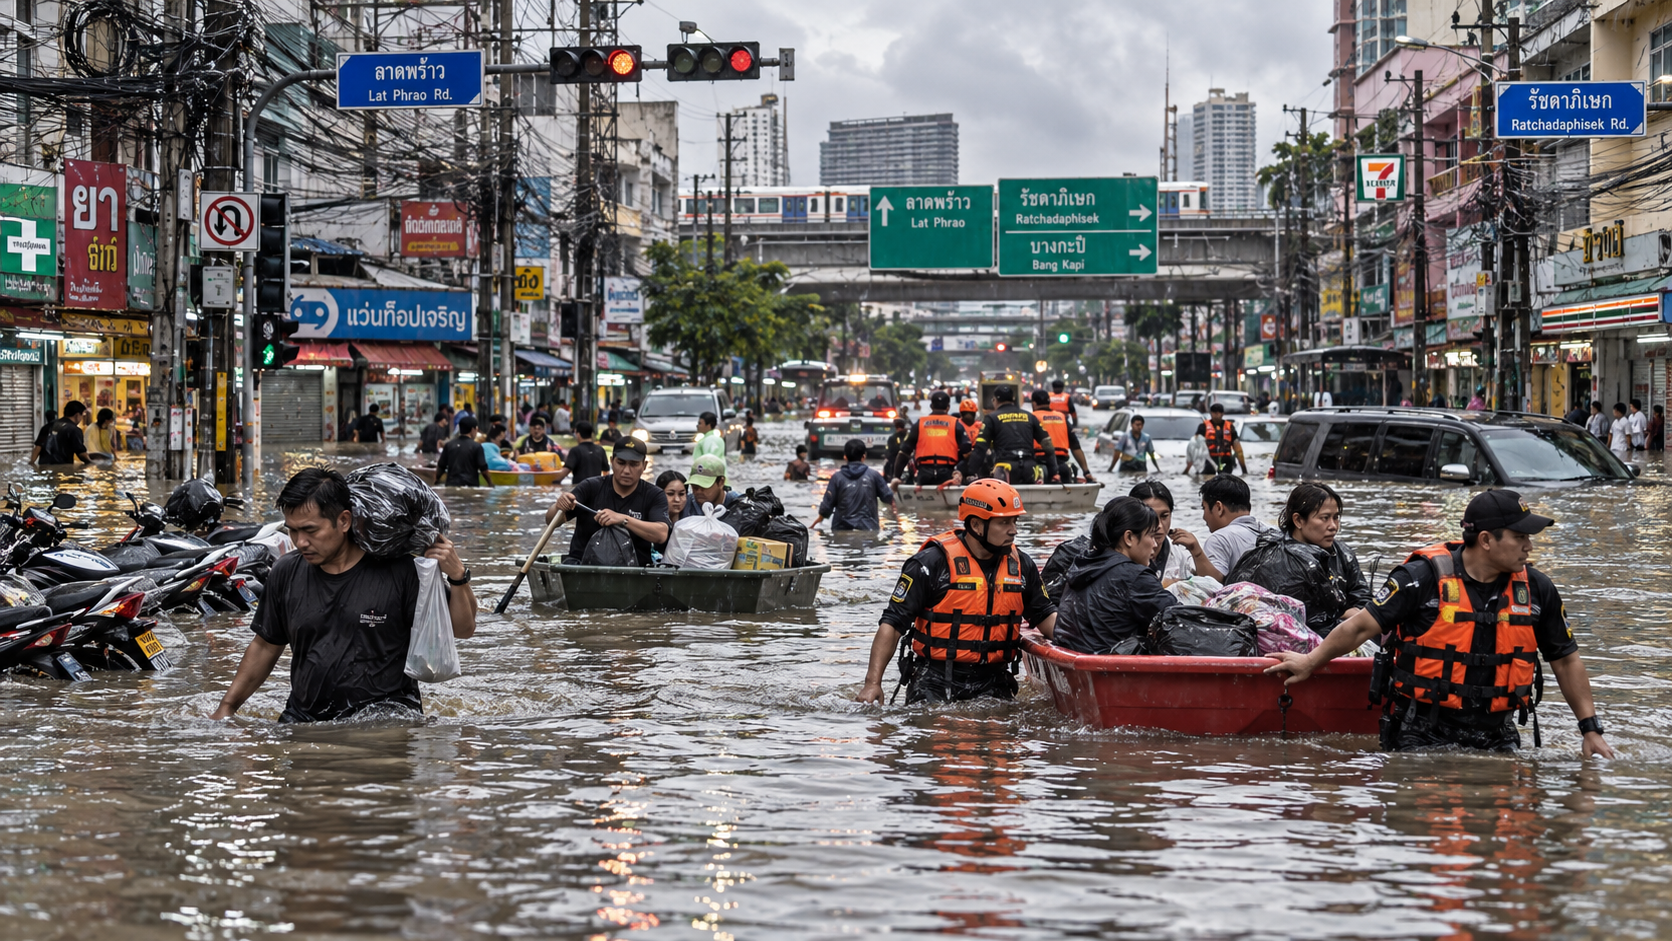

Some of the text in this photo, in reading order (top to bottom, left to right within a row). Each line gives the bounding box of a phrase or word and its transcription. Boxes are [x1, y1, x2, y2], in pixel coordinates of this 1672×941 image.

[375, 57, 445, 80] ลาดพร้าว
[368, 88, 453, 102] Lat Phrao Rd.
[1528, 87, 1612, 110] รัชดาภิเษก
[1511, 117, 1630, 133] Ratchadaphisek Rd.
[905, 189, 971, 211] ลาดพร้าว
[1019, 186, 1096, 207] รัชดาภิเษก
[72, 184, 119, 232] ยา
[911, 216, 966, 229] Lat Phrao
[1015, 212, 1100, 227] Ratchadaphisek
[1032, 258, 1085, 273] Bang Kapi
[347, 300, 466, 332] แว่นท็อปเจริญ
